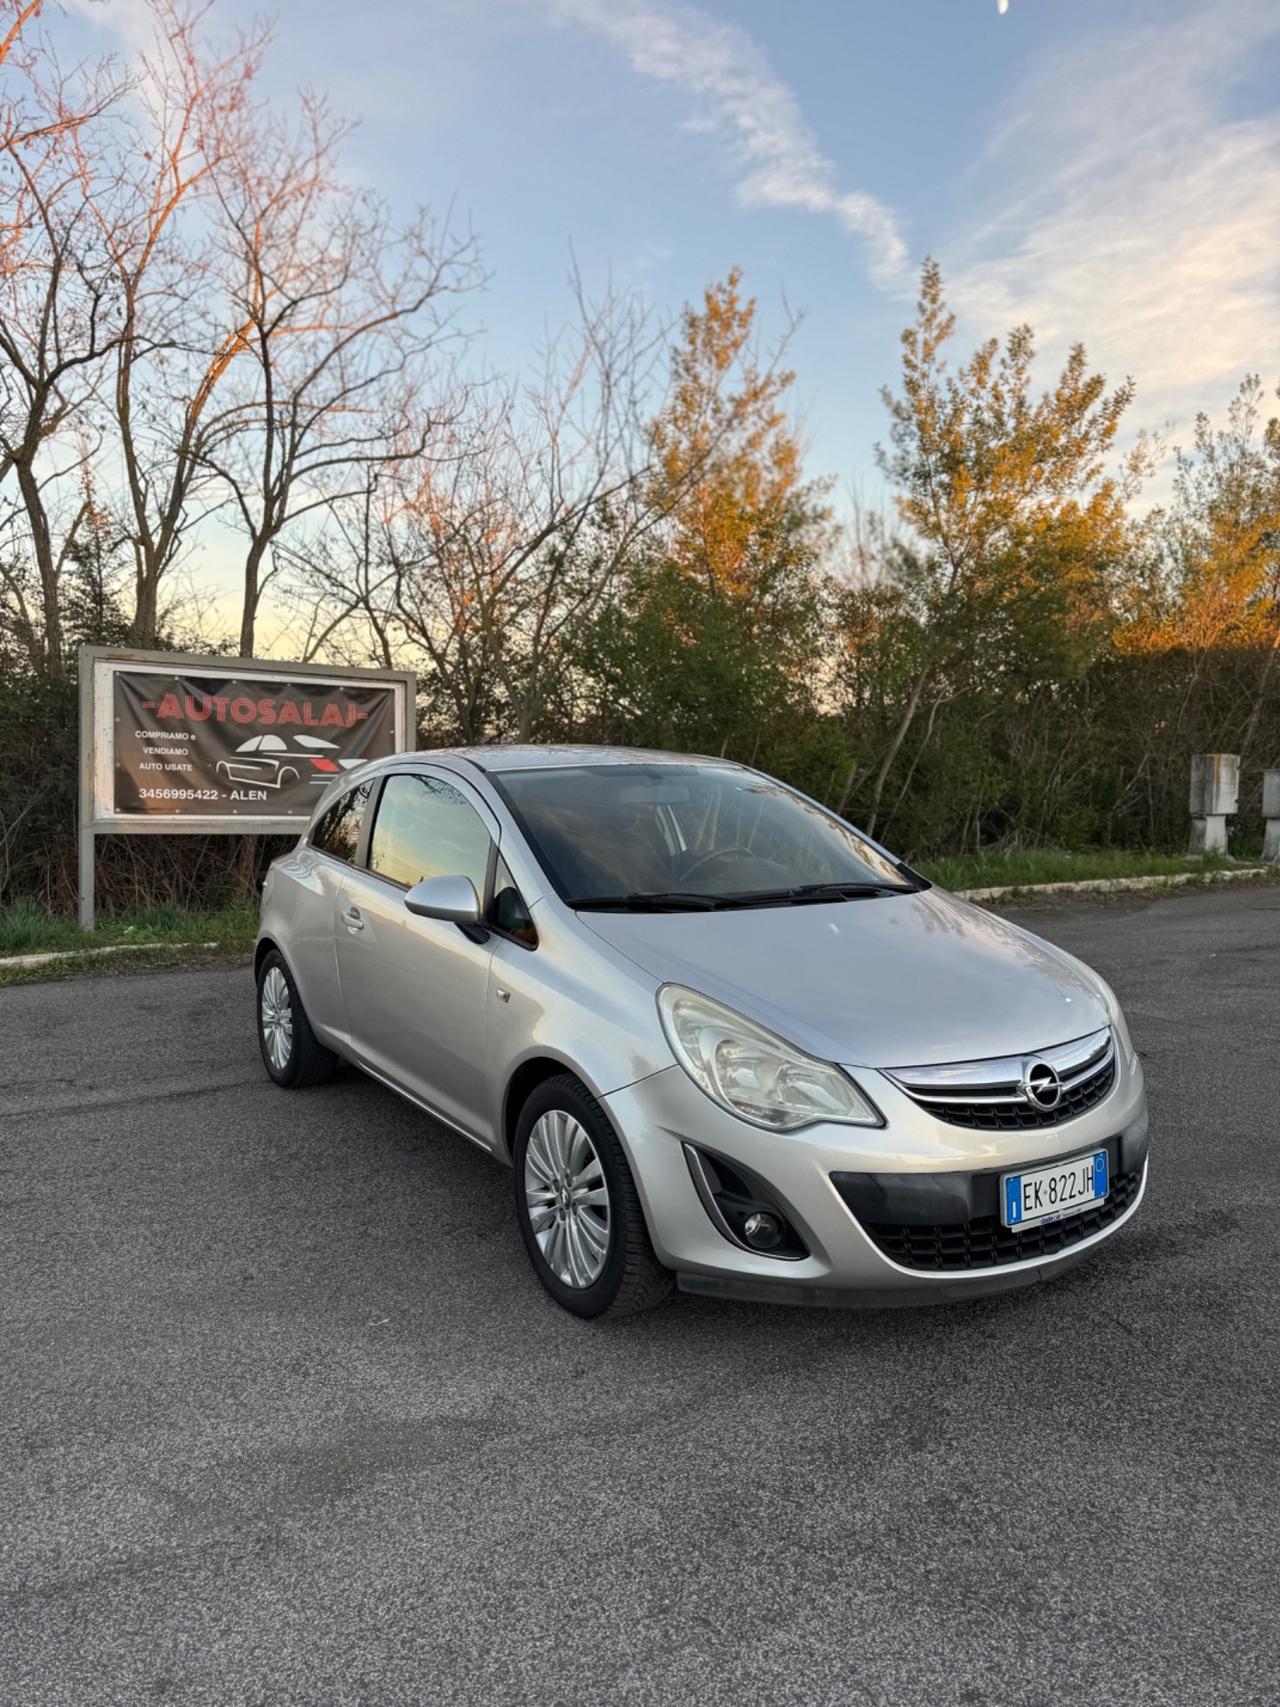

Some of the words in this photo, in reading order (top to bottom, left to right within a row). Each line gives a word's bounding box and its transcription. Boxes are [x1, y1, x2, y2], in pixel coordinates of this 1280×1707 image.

[135, 730, 189, 740] COMPRIAMO
[142, 746, 189, 756] VENDIAMO
[139, 762, 163, 771] AUTO
[164, 763, 193, 772] USATE
[139, 788, 218, 800] 3456995422
[230, 790, 267, 801] ALEN
